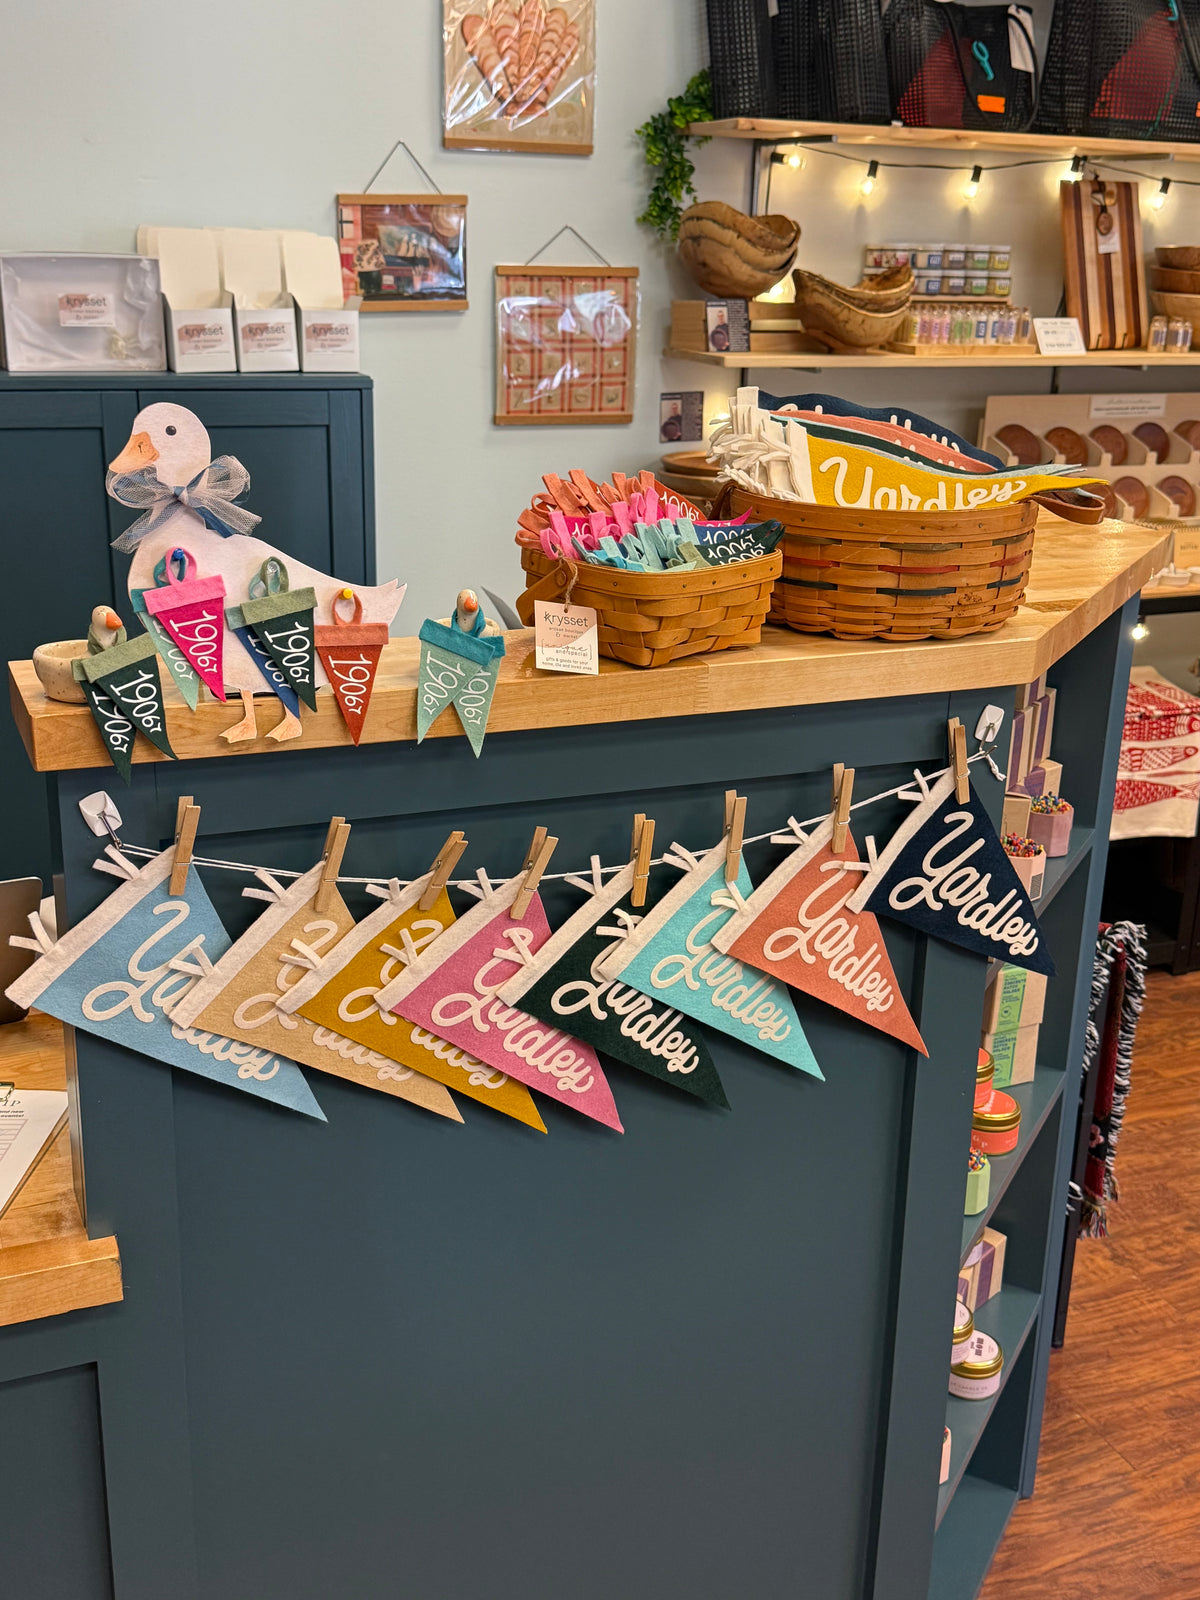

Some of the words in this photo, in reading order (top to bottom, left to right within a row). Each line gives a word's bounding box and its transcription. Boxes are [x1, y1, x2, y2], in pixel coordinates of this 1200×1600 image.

[169, 610, 218, 673] 19067
[543, 611, 588, 628] krysset
[264, 621, 310, 684] 19067
[328, 653, 372, 715] 19067
[423, 650, 466, 716] 19067
[110, 669, 162, 733] 19067
[888, 811, 1039, 956] Yardley
[763, 860, 894, 1012] Yardley
